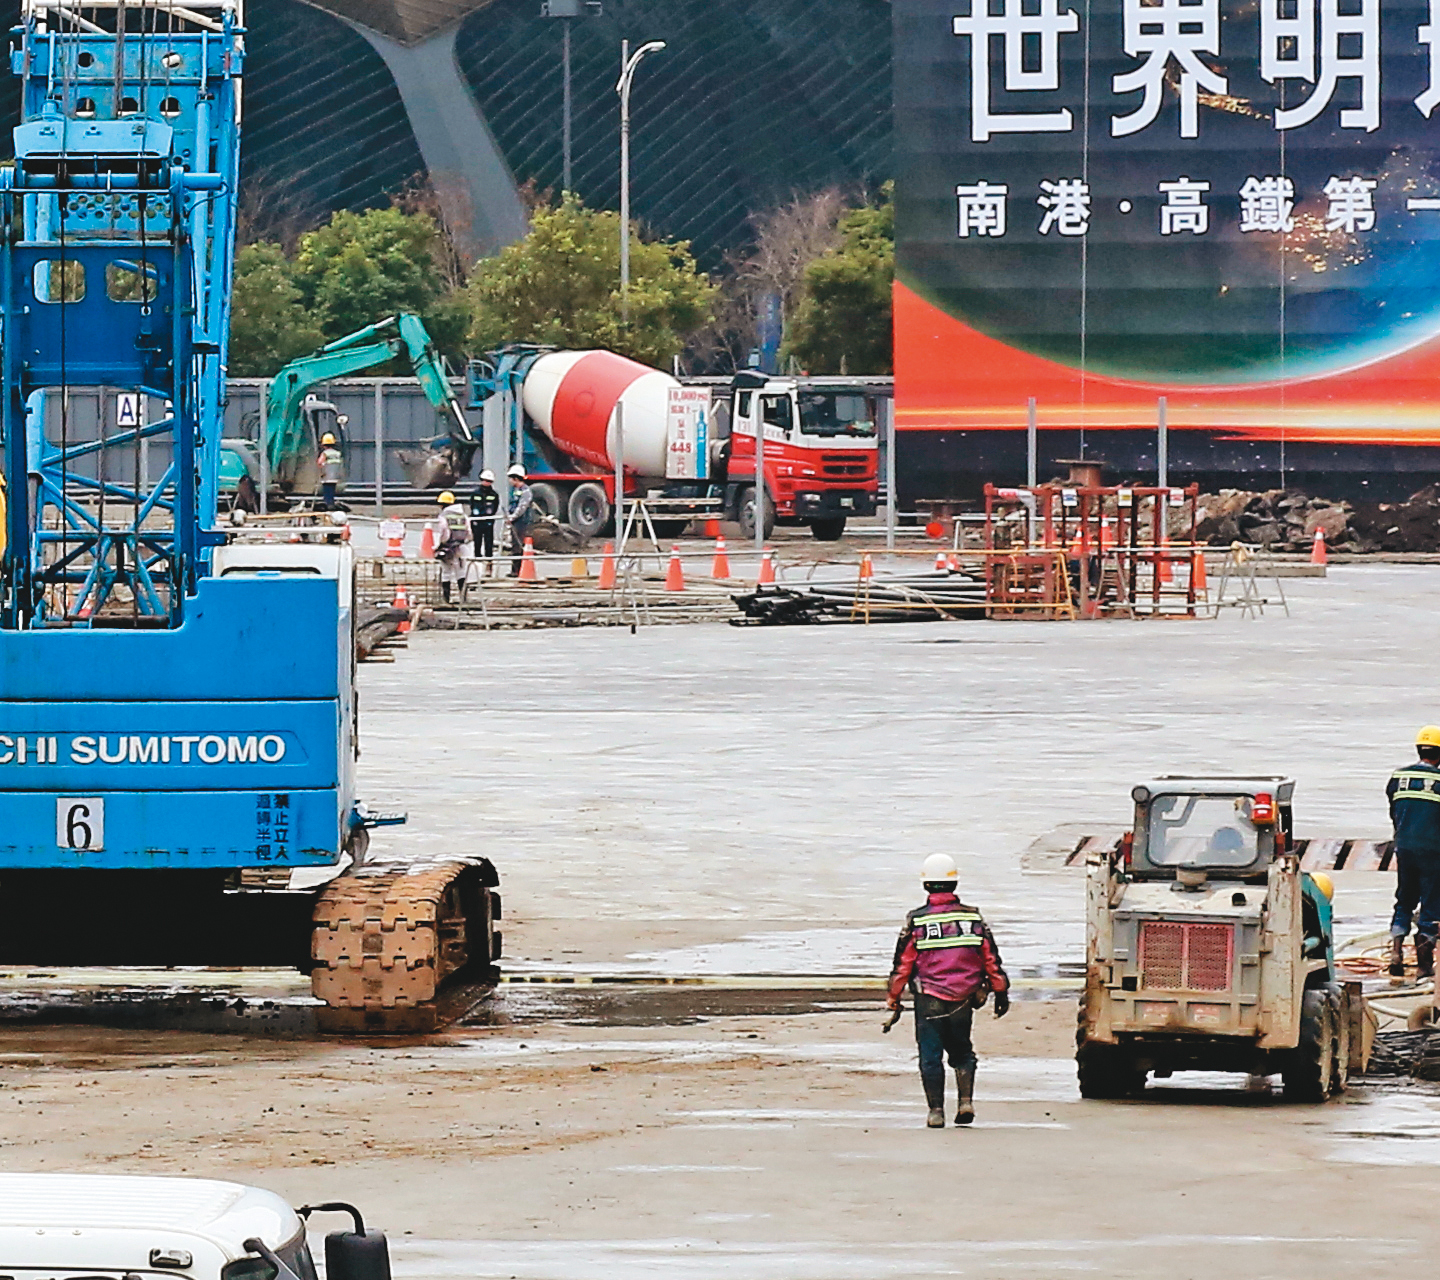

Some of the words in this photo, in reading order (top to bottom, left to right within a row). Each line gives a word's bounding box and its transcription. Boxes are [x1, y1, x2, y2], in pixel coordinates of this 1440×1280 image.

[670, 442, 691, 453] 448
[70, 734, 286, 763] SUMITOMO
[66, 804, 92, 850] 6
